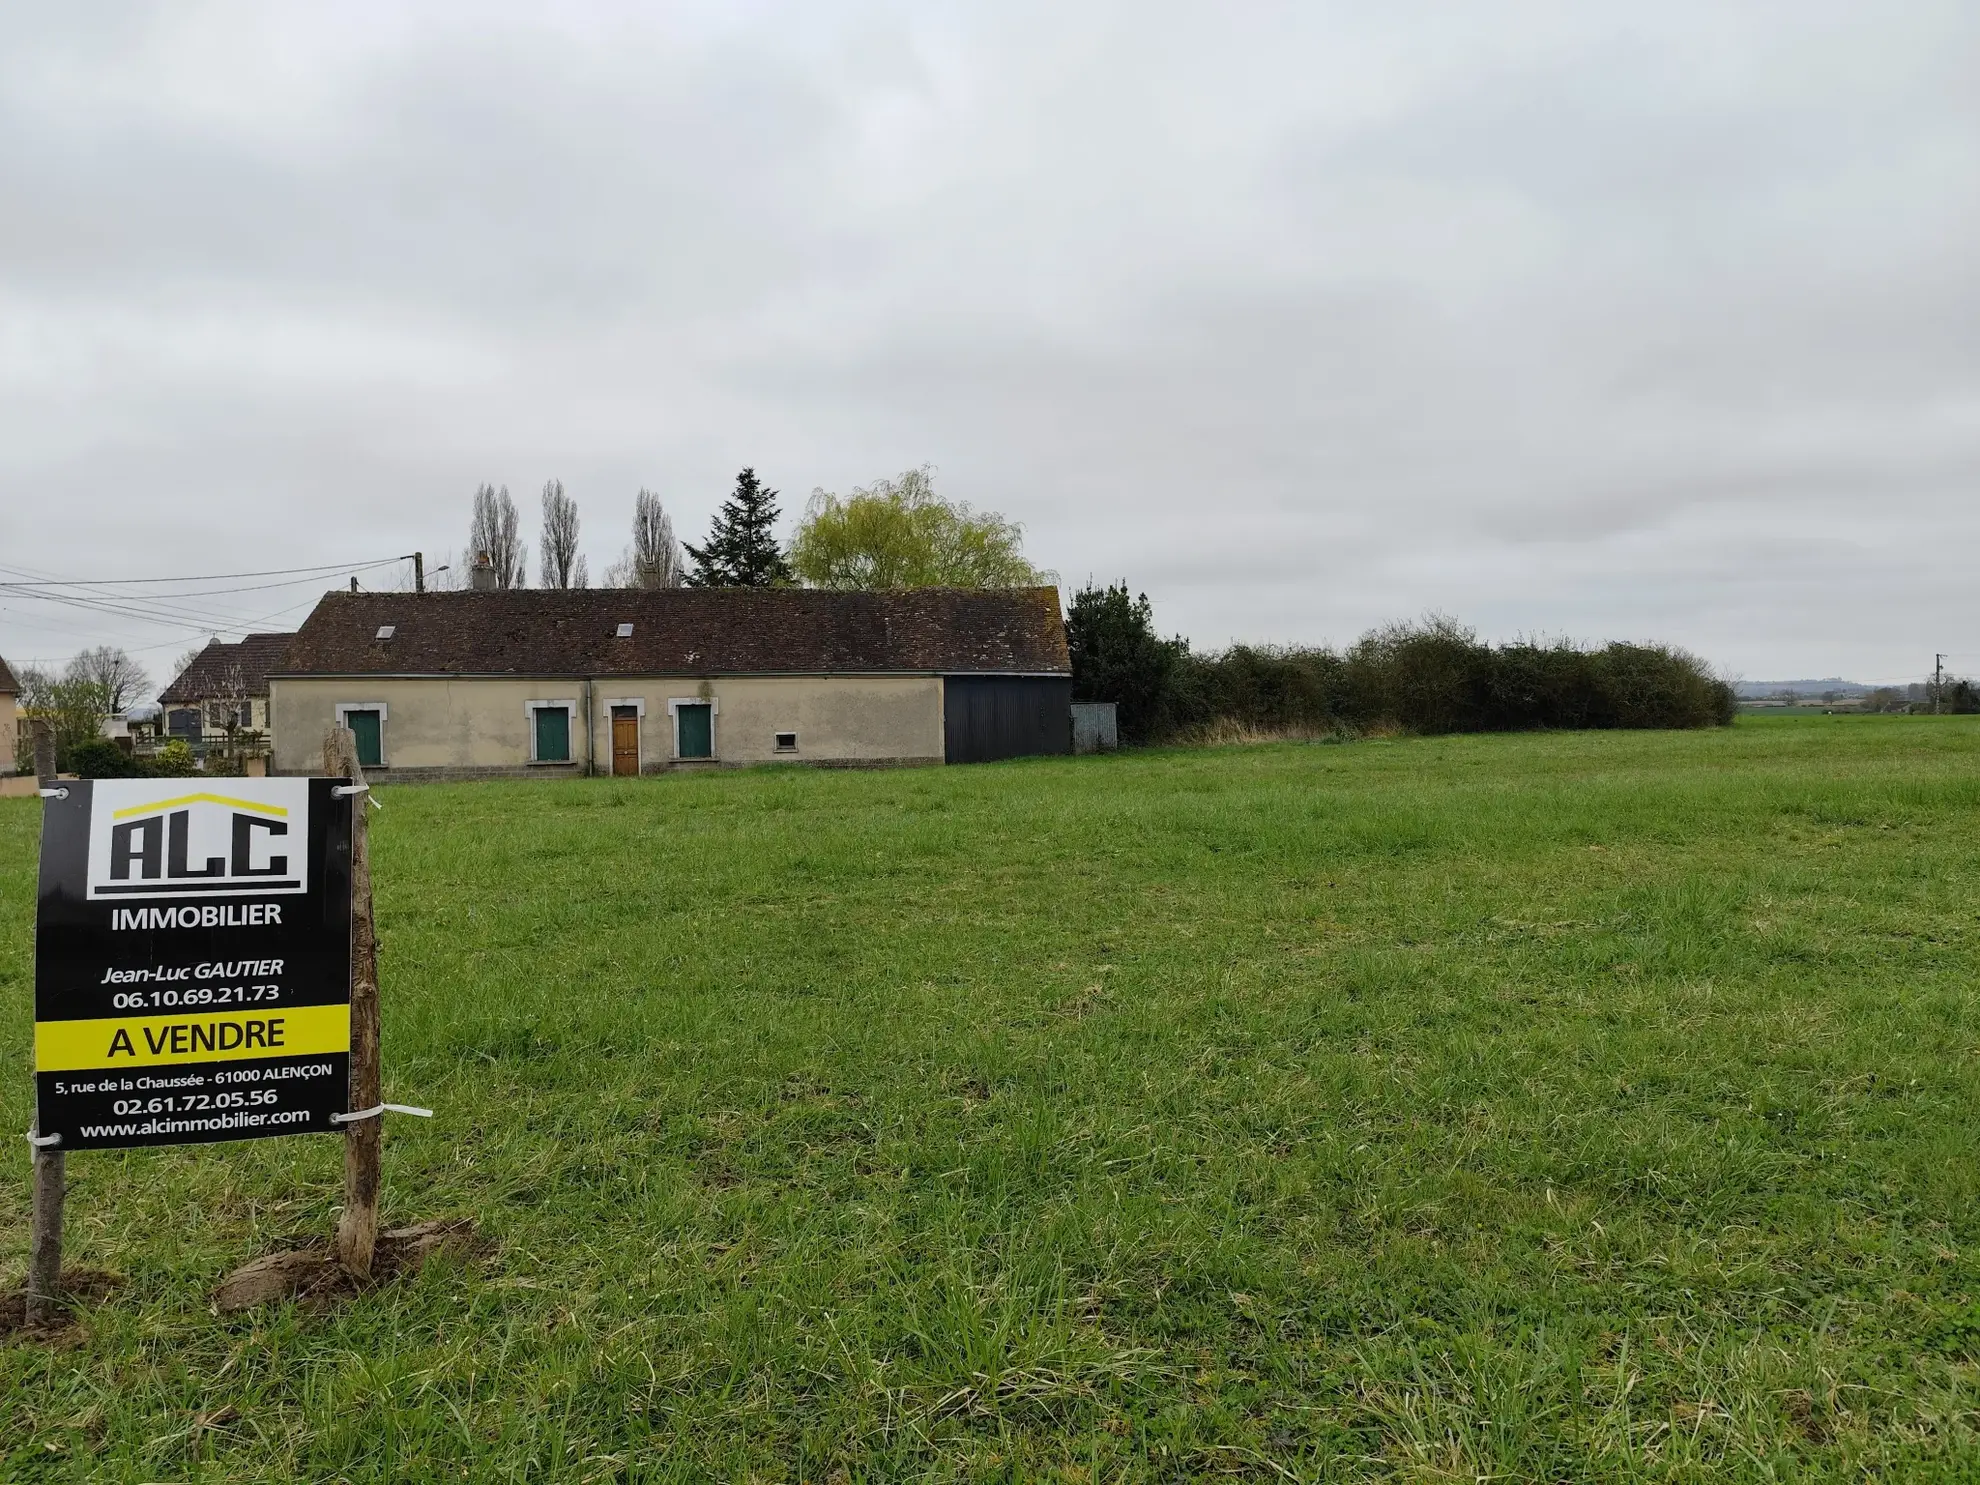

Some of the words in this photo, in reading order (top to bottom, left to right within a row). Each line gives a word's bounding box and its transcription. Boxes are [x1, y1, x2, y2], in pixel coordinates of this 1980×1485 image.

[110, 810, 288, 880] ALC
[112, 904, 282, 930] IMMOBILIER
[101, 964, 191, 984] Jean-Luc
[194, 959, 284, 980] GAUTIER
[113, 985, 280, 1009] 06.10.69.21.73
[107, 1028, 136, 1058] A
[143, 1018, 285, 1055] VENDRE
[55, 1082, 69, 1096] 5,
[71, 1082, 96, 1093] rue
[98, 1079, 118, 1092] de
[120, 1078, 134, 1091] la
[136, 1074, 205, 1090] Chaussée
[215, 1069, 261, 1084] 61000
[263, 1064, 333, 1081] ALENÇON
[113, 1089, 278, 1116] 02.61.72.05.56
[80, 1109, 310, 1138] www.alcimmobilier.com
